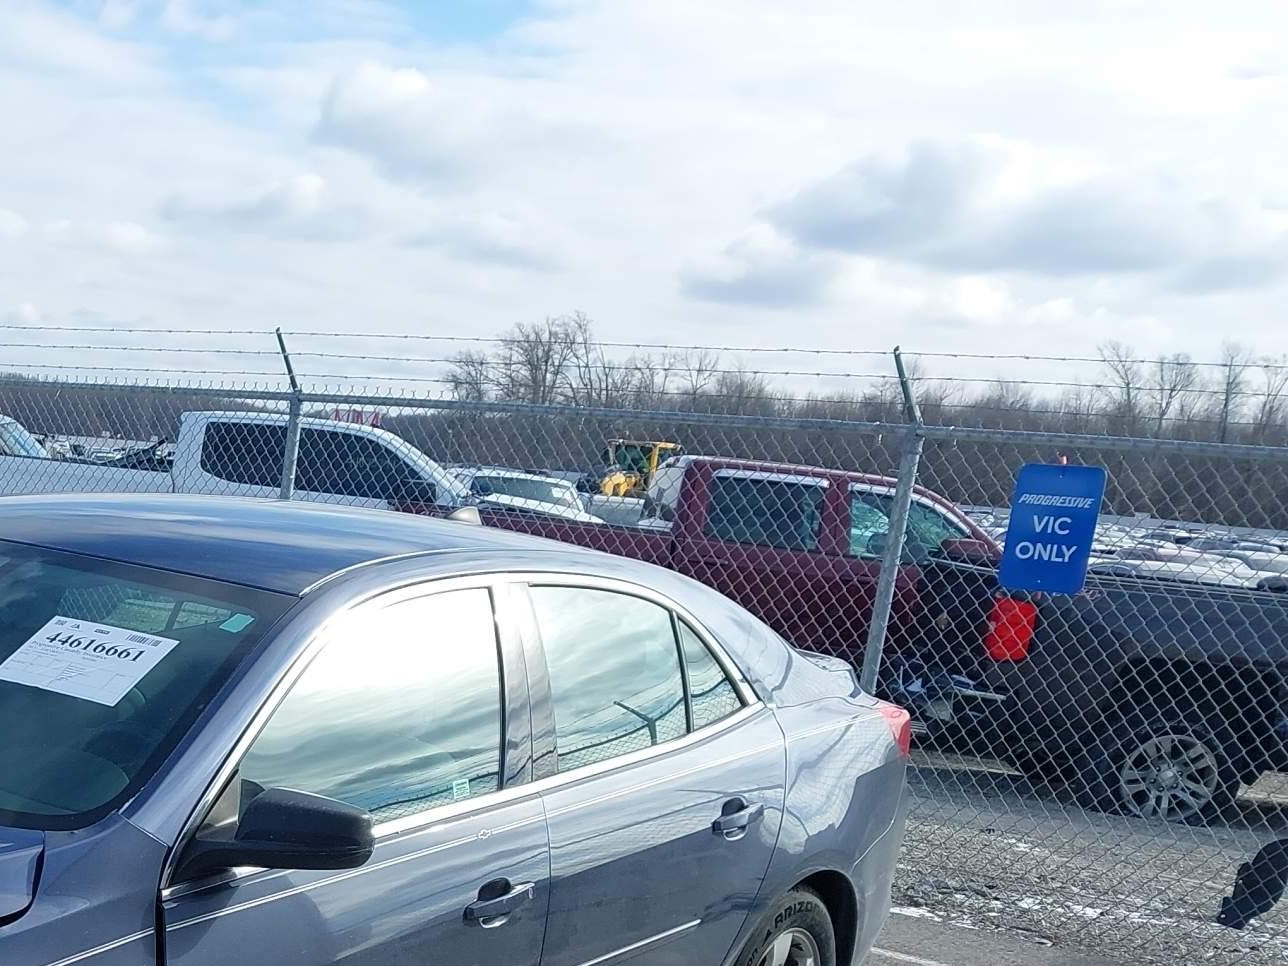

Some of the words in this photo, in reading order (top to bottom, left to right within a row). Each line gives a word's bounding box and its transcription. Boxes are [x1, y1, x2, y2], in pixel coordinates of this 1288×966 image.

[1018, 493, 1095, 508] PROGRESSIVE
[1032, 514, 1073, 535] VIC
[1015, 541, 1078, 563] ONLY
[45, 631, 146, 662] 44616661
